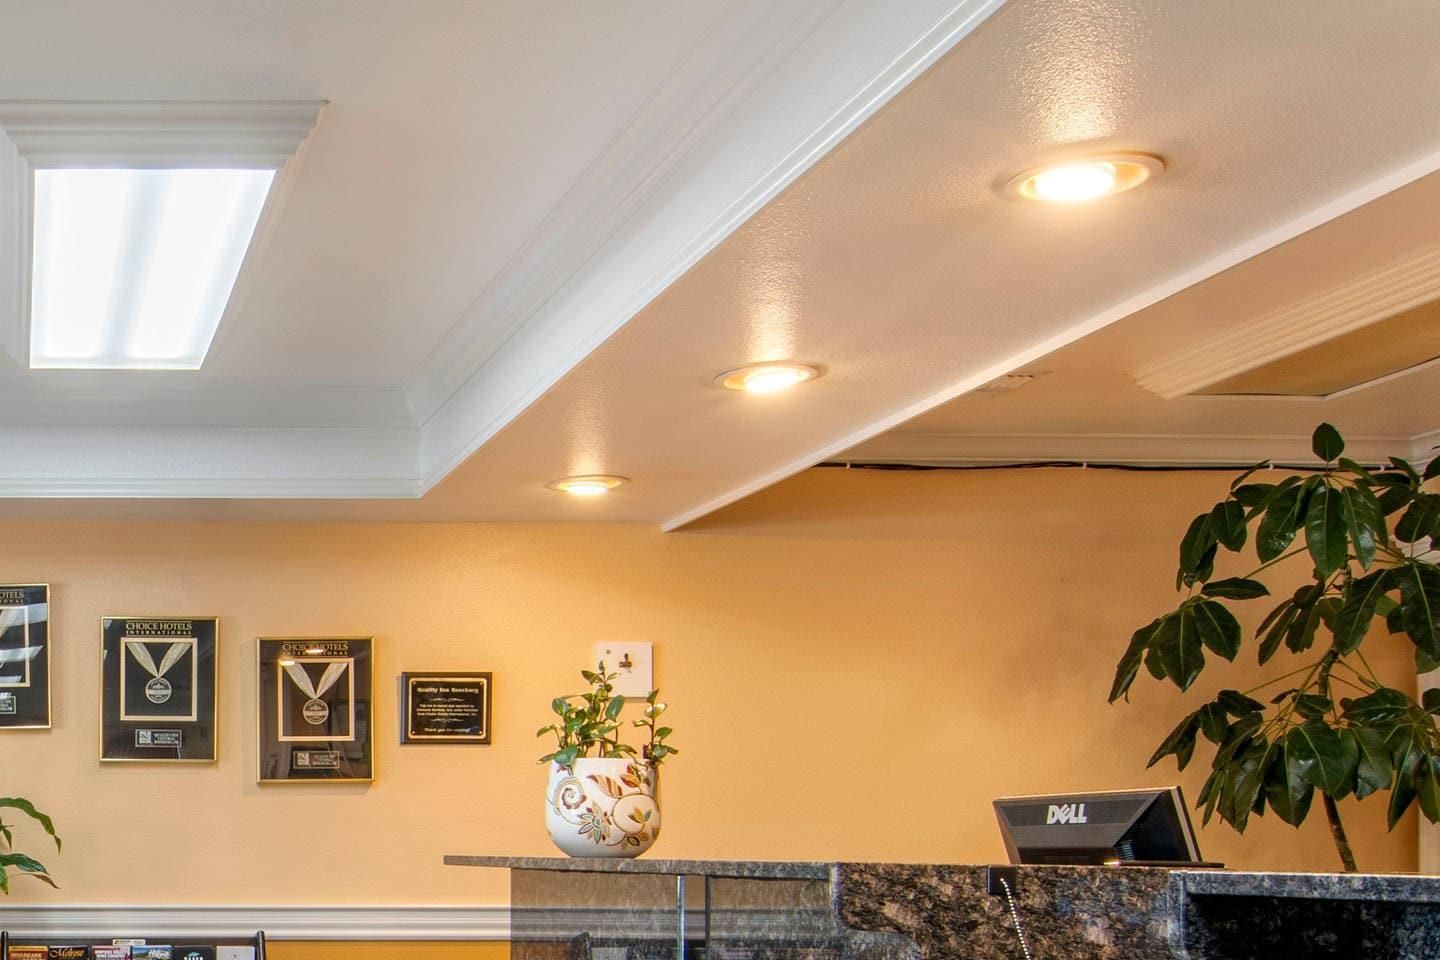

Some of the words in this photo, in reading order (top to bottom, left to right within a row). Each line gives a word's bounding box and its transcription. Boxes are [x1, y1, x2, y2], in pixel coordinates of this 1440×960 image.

[126, 622, 159, 630] CHOICE
[160, 622, 193, 631] HOTELS
[1046, 803, 1088, 825] DELL
